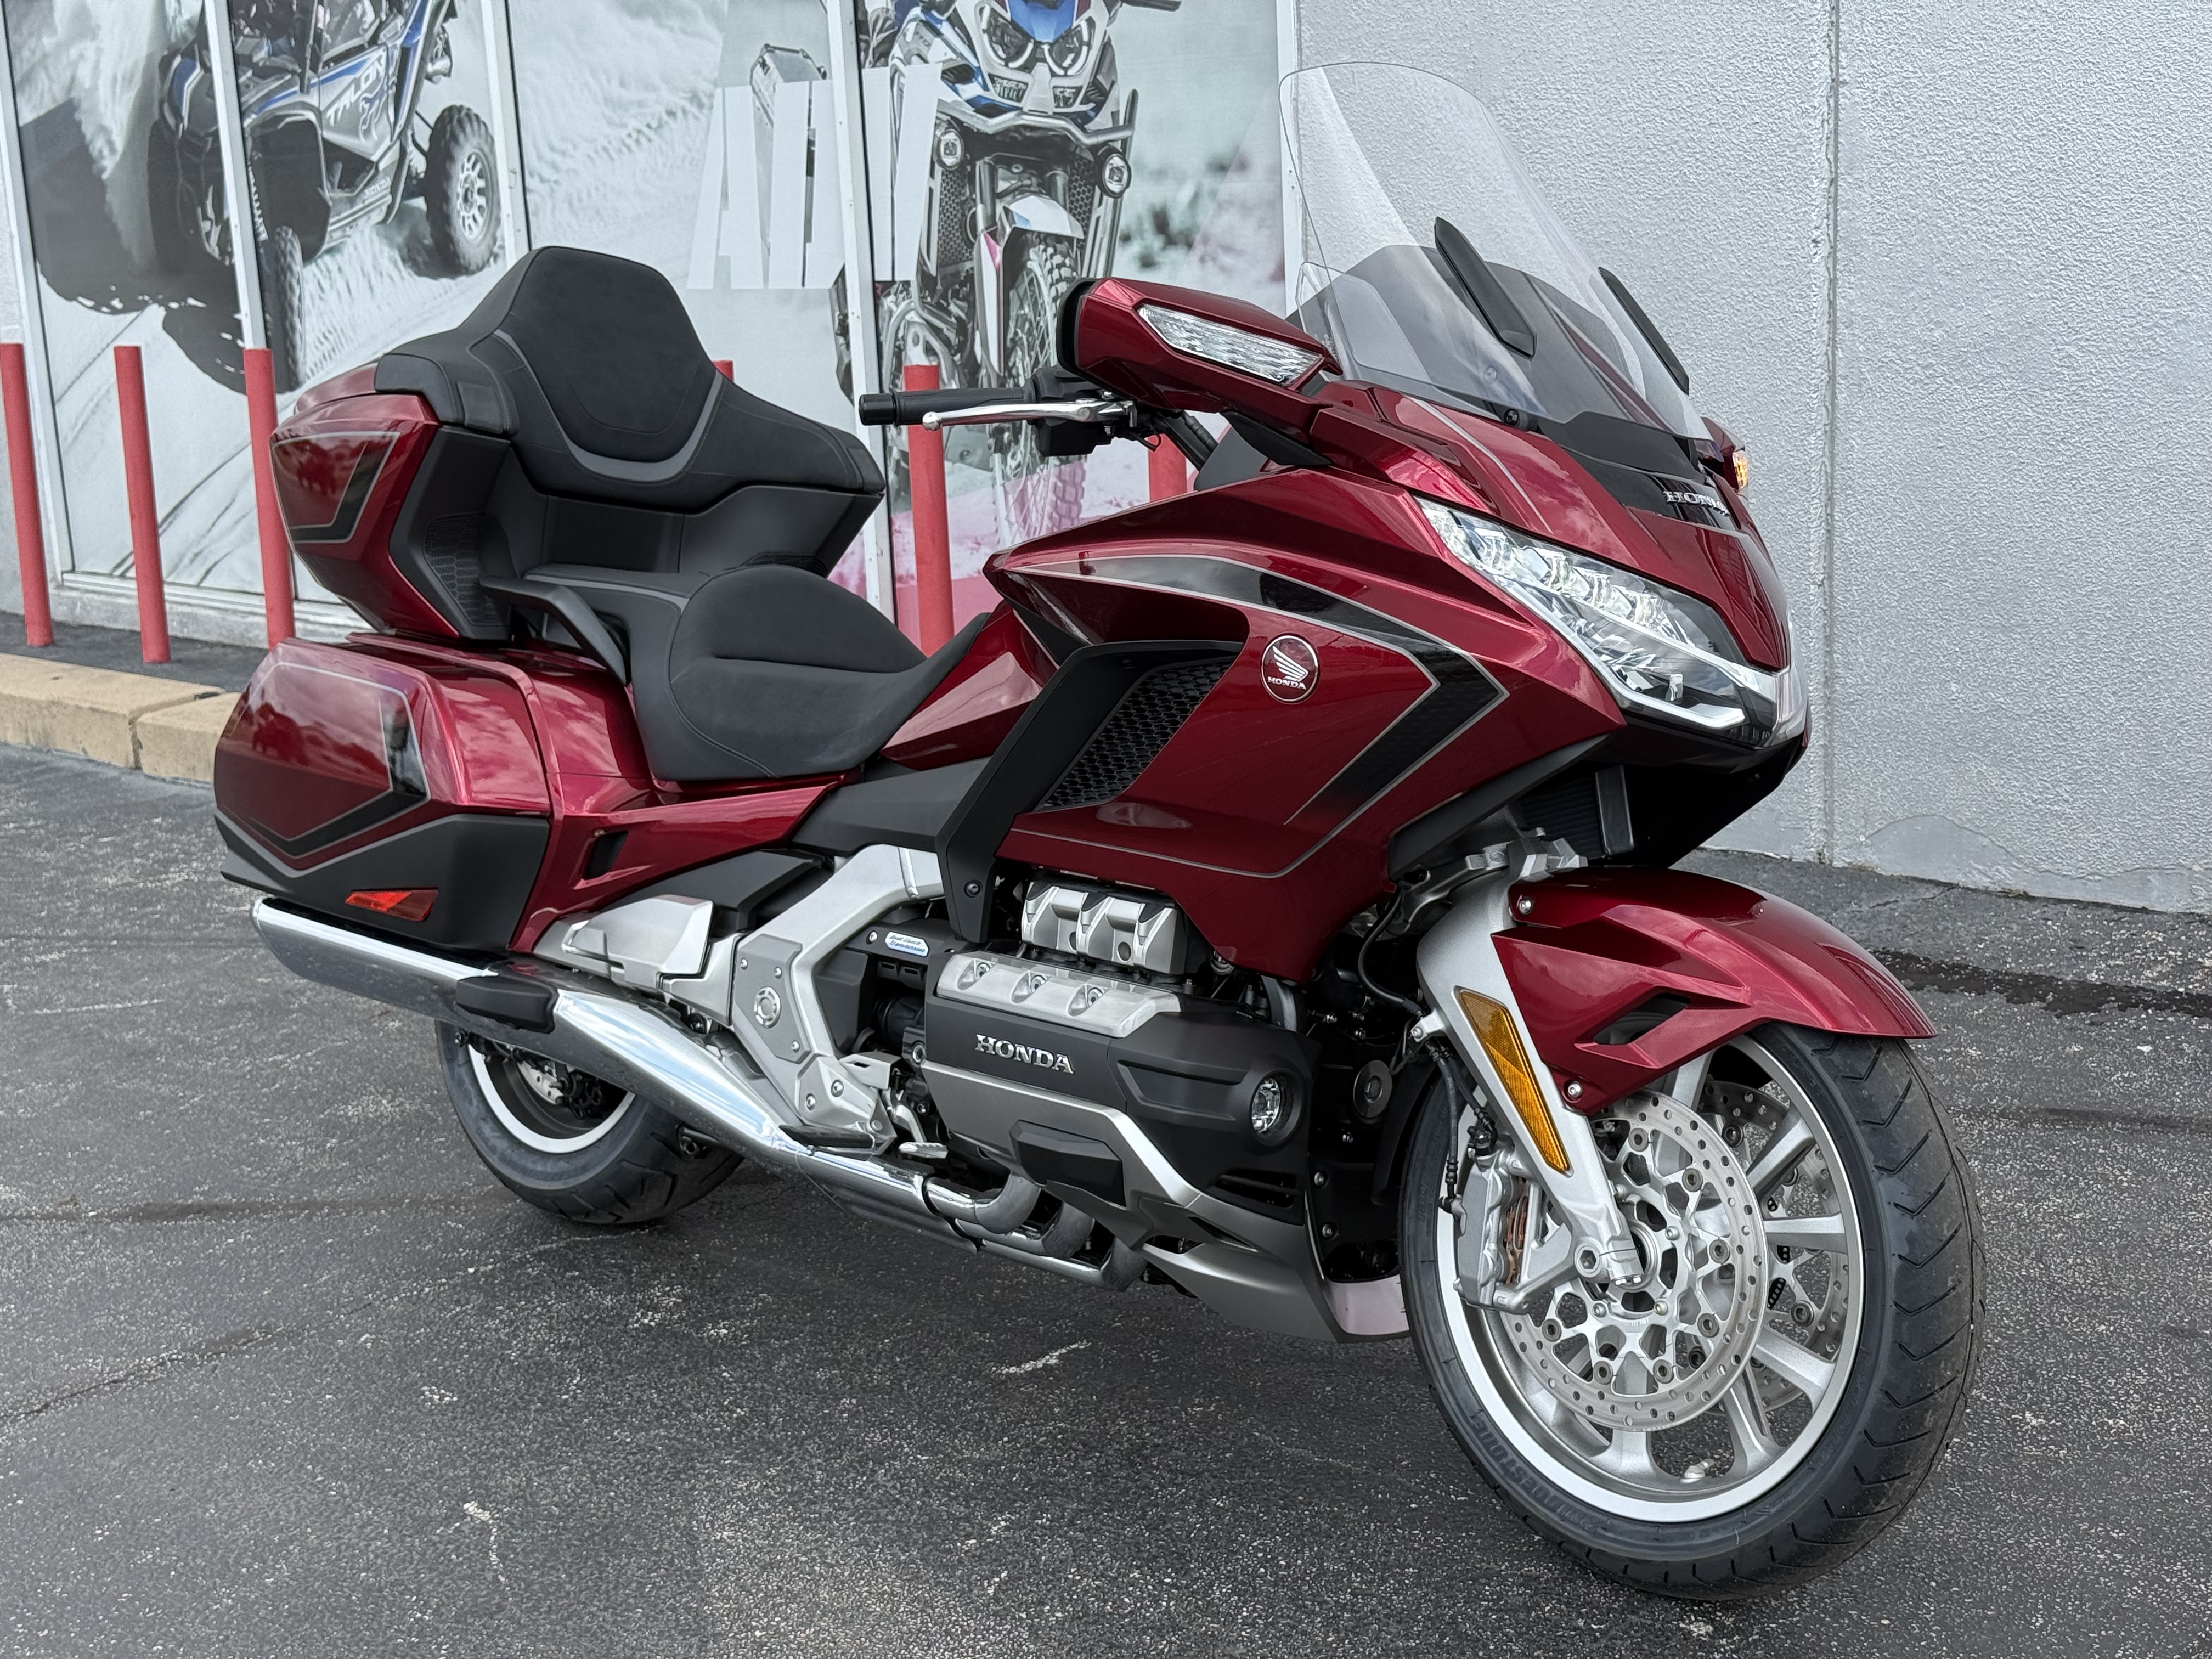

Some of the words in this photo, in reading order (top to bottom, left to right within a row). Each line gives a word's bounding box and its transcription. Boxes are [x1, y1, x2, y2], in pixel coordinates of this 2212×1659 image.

[325, 53, 385, 127] TALON
[1267, 676, 1307, 690] HONDA
[975, 1034, 1074, 1075] HONDA
